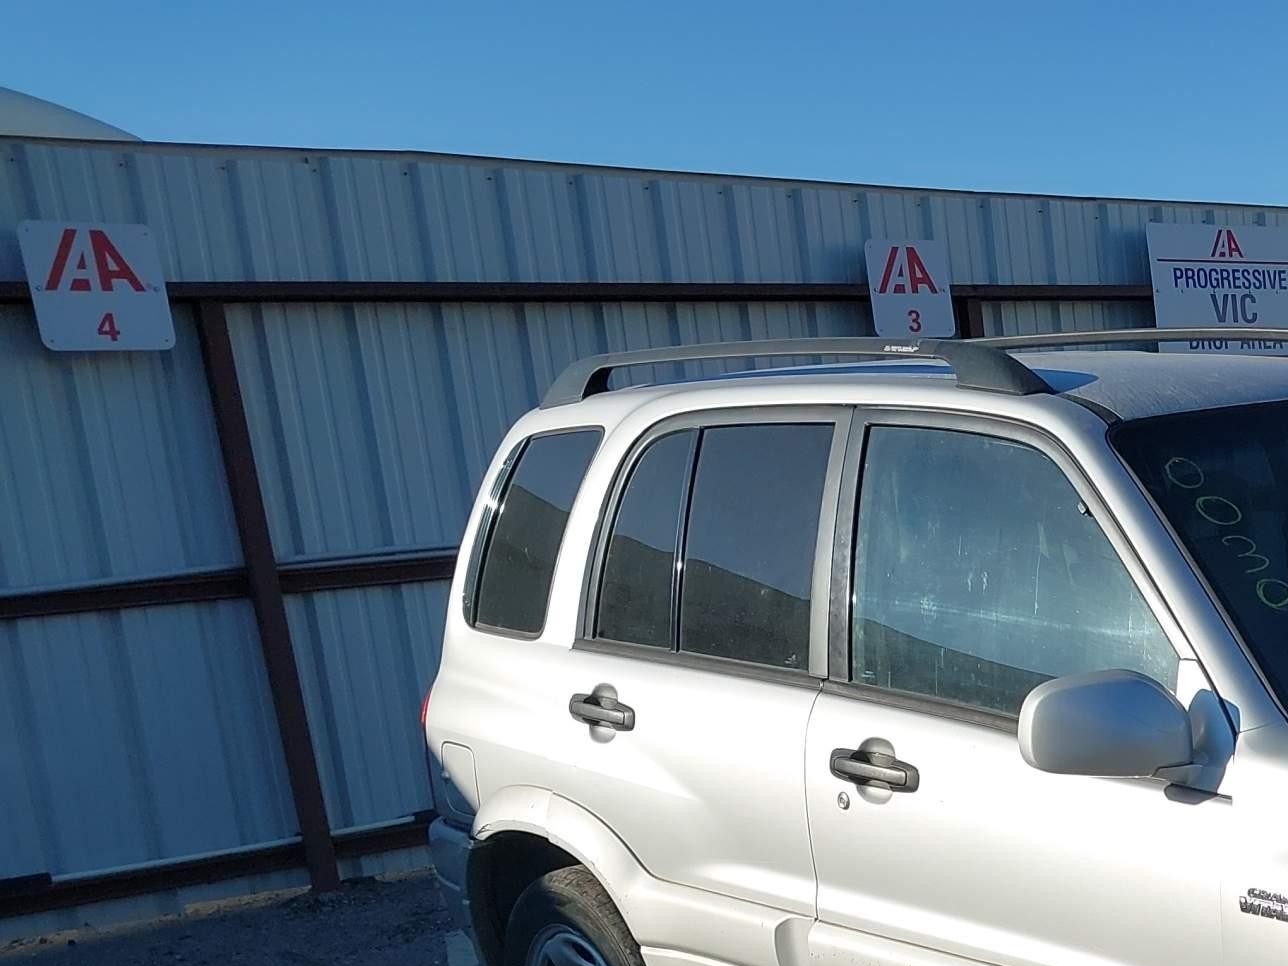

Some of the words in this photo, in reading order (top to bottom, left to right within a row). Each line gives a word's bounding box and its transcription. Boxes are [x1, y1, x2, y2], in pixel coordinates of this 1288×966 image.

[1172, 266, 1288, 290] PROGRESSIVE
[1209, 293, 1259, 324] VIC
[97, 312, 121, 341] 4
[907, 310, 922, 334] 3
